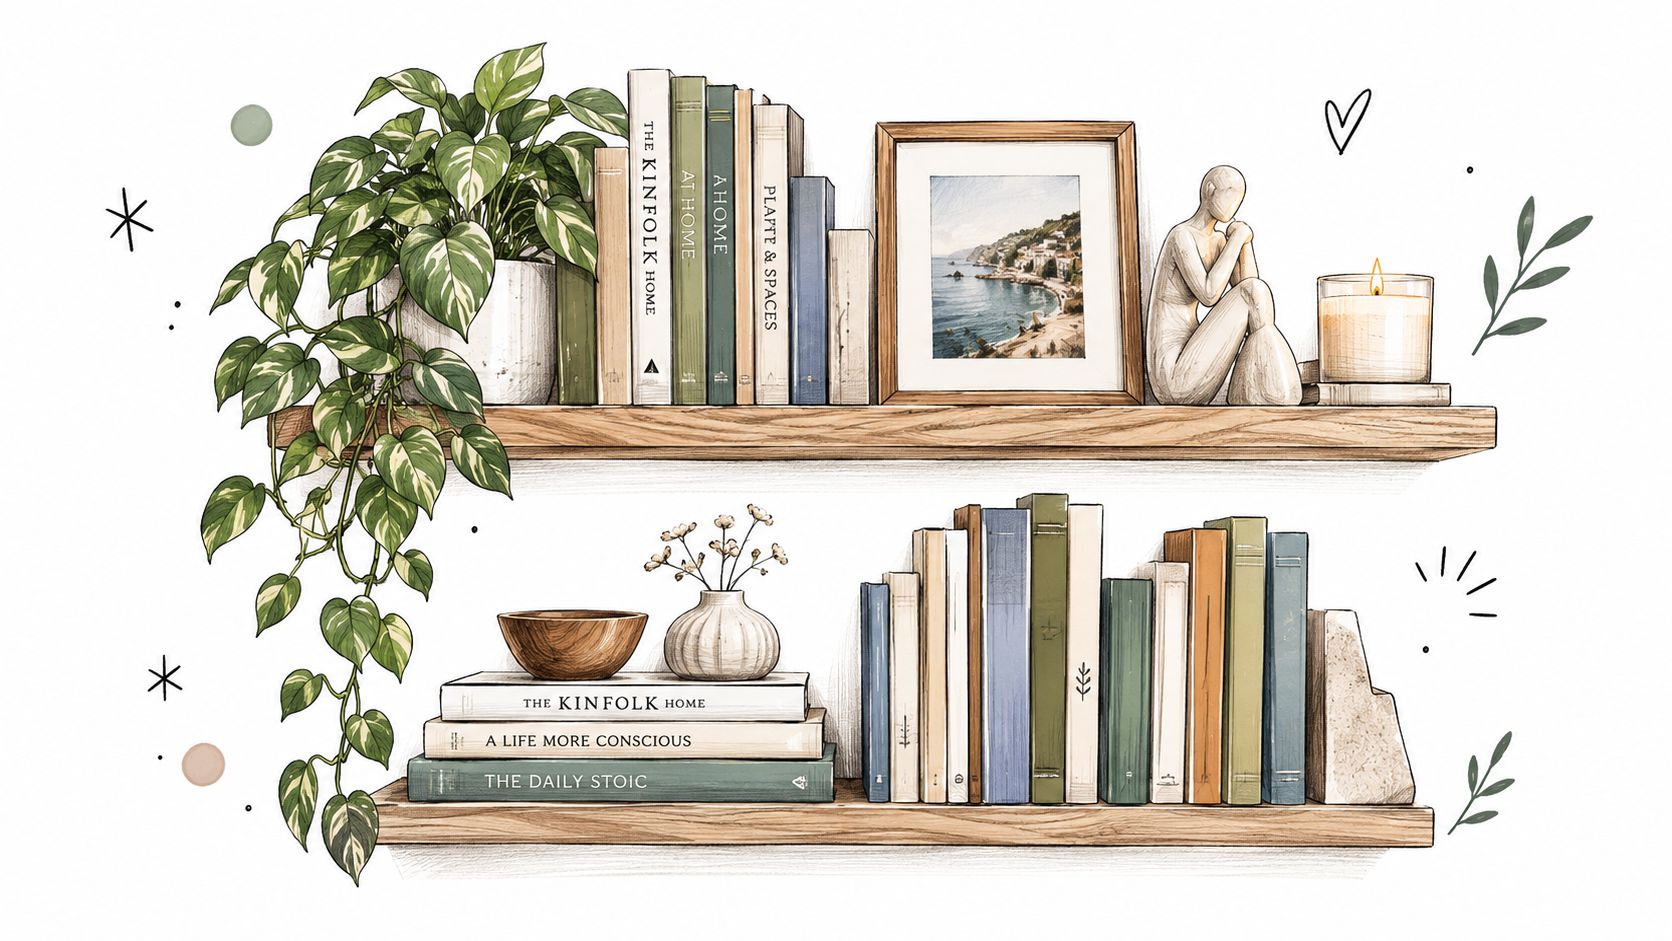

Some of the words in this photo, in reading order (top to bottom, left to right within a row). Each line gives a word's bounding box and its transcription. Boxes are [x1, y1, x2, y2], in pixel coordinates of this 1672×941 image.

[643, 120, 655, 151] THE
[681, 169, 695, 190] AT
[642, 158, 658, 265] KINFOLK
[681, 198, 696, 260] HOME
[764, 250, 777, 265] &
[645, 270, 656, 316] HOME
[764, 268, 778, 331] SPACES
[523, 698, 552, 709] THE
[558, 695, 660, 711] KINFOLK
[665, 698, 706, 709] HOME
[485, 734, 498, 748] A
[503, 734, 537, 748] LIFE
[543, 734, 591, 748] MORE
[596, 734, 692, 748] CONSCIOUS
[484, 774, 522, 789] THE
[529, 774, 584, 789] DAILY
[591, 774, 648, 789] STOIC
